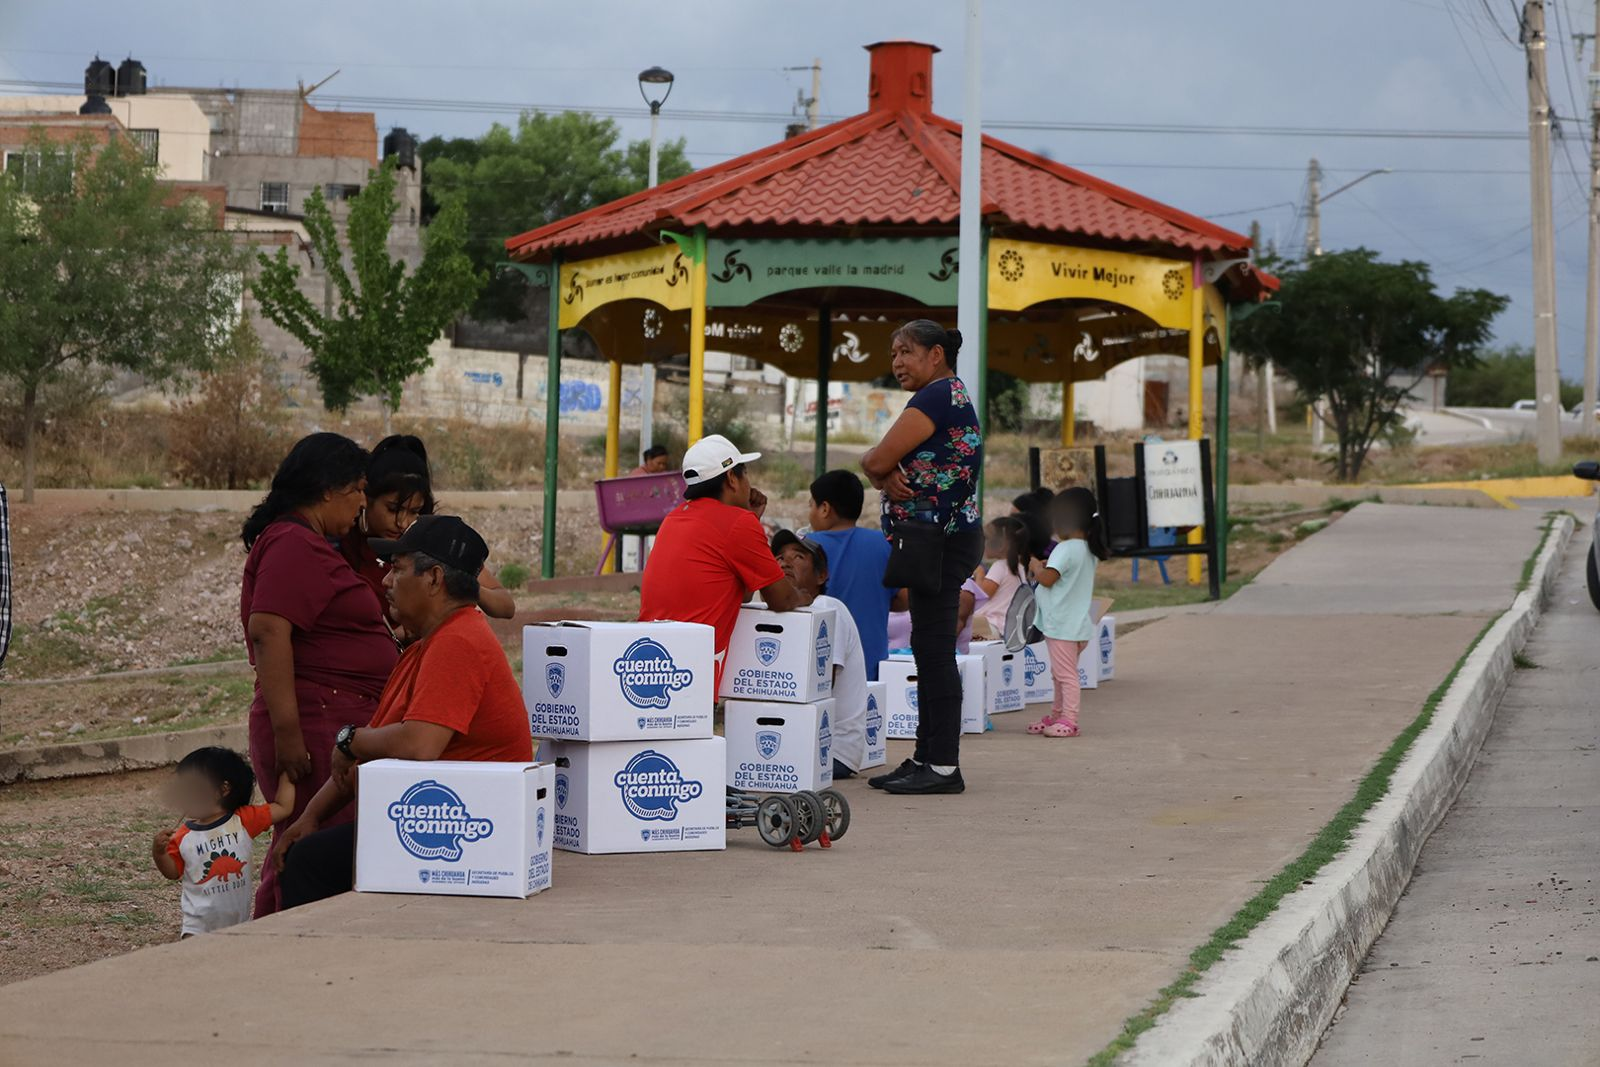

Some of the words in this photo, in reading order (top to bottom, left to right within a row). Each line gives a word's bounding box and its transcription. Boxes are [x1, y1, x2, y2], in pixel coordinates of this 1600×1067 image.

[631, 264, 664, 279] comunidad
[767, 264, 808, 277] parque
[814, 264, 841, 275] valle
[847, 264, 858, 275] la
[863, 264, 904, 275] madrid
[1051, 261, 1088, 279] Vivir
[1093, 266, 1135, 288] Mejor
[614, 656, 674, 673] cuenta
[625, 671, 692, 689] conmigo
[739, 669, 794, 680] GOBIERNO
[734, 678, 753, 686] DEL
[756, 680, 797, 690] ESTADO
[747, 687, 797, 697] CHIHUAHUA
[535, 702, 577, 715] GOBIERNO
[532, 714, 547, 724] DEL
[549, 714, 580, 727] ESTADO
[888, 721, 905, 729] DEL
[532, 724, 541, 733] DE
[542, 725, 580, 736] CHIHUAHUA
[740, 763, 795, 774] GOBIERNO
[616, 768, 681, 785] cuenta
[735, 771, 754, 780] DEL
[757, 773, 798, 782] ESTADO
[627, 783, 701, 800] conmigo
[748, 780, 798, 790] CHIHUAHUA
[389, 802, 468, 820] cuenta
[403, 819, 491, 840] conmigo
[195, 832, 239, 856] MIGHTY
[530, 851, 549, 867] GOBIERNO
